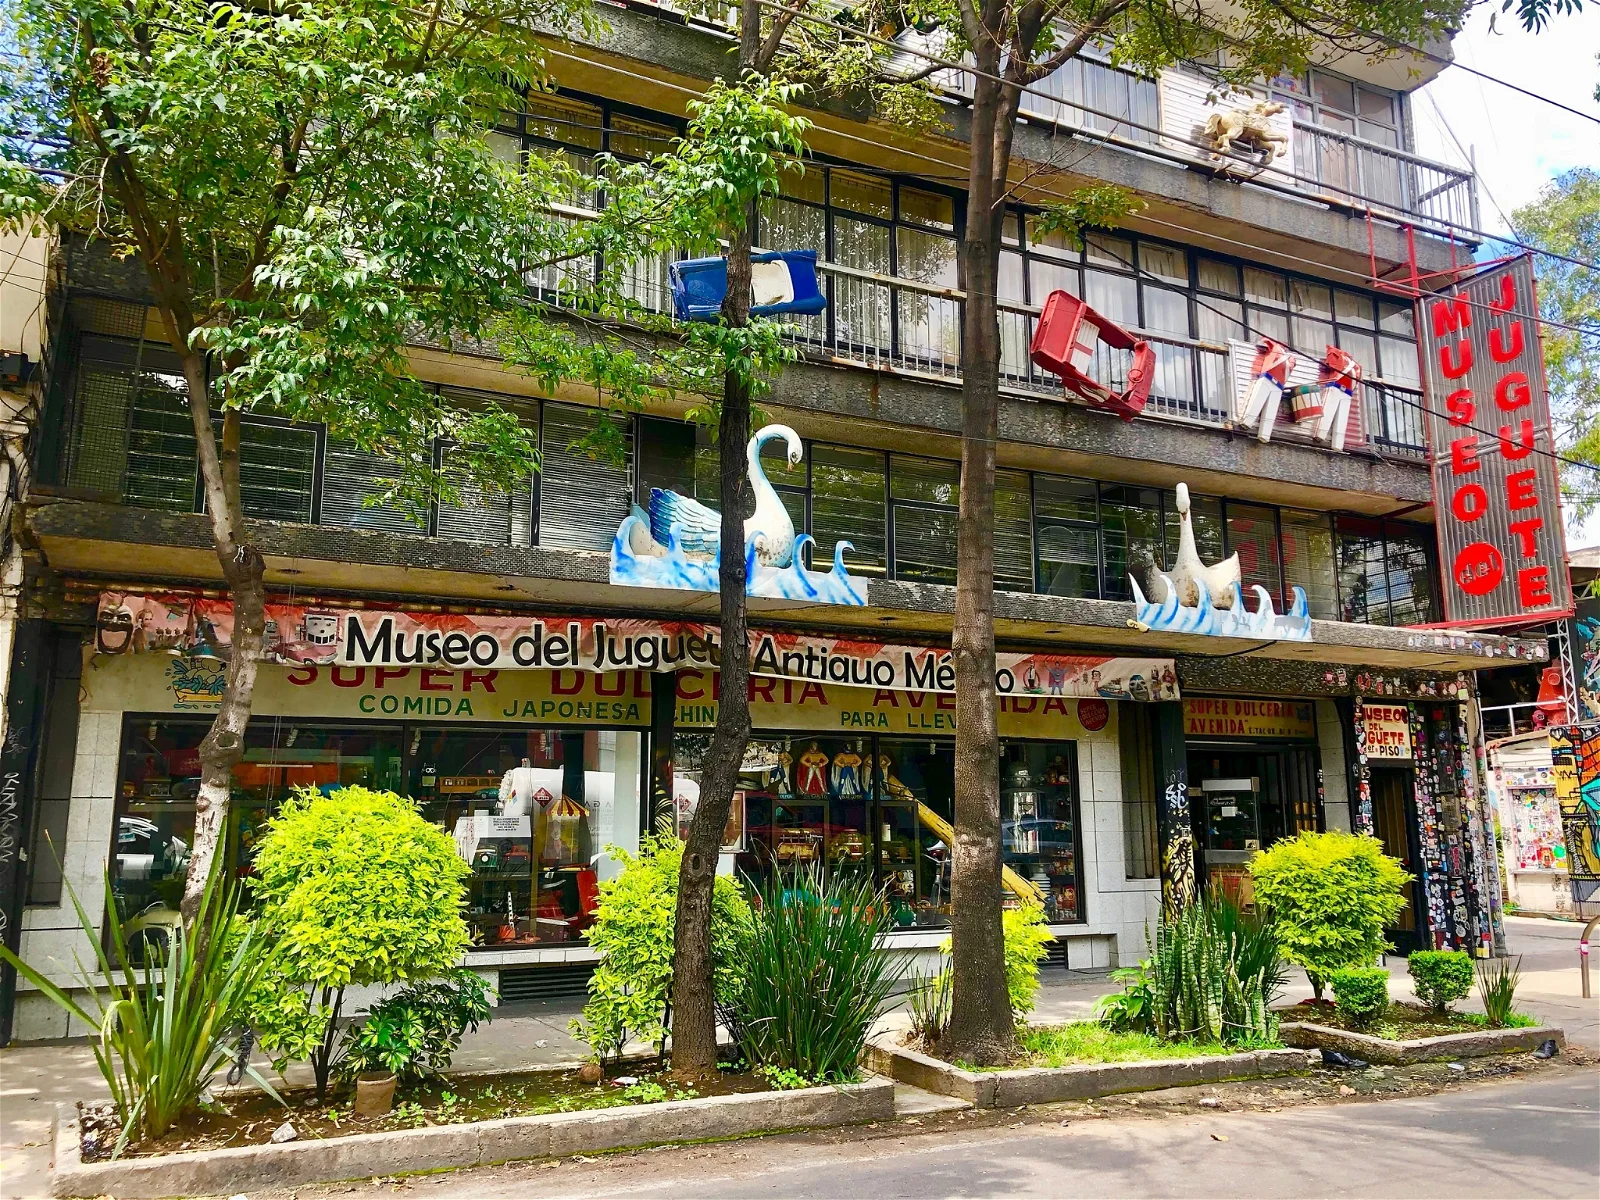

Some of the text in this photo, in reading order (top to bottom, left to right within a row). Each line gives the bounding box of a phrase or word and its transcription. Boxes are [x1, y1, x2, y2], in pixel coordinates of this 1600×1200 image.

[1431, 291, 1488, 522] MUSEO
[1488, 273, 1552, 608] JUGUETE
[1459, 552, 1500, 585] del
[345, 616, 499, 667] Museo
[512, 623, 579, 666] del
[593, 624, 721, 671] Juguet
[905, 652, 1015, 694] Méo
[358, 694, 474, 716] COMIDA
[503, 699, 640, 720] JAPONESA
[840, 711, 889, 727] PARA
[872, 688, 1069, 716] AVEIDA
[1189, 699, 1229, 716] SUPER
[1363, 707, 1402, 721] USEO
[1366, 731, 1405, 745] GUETE
[1368, 722, 1383, 731] DEL
[1379, 745, 1400, 756] PISO
